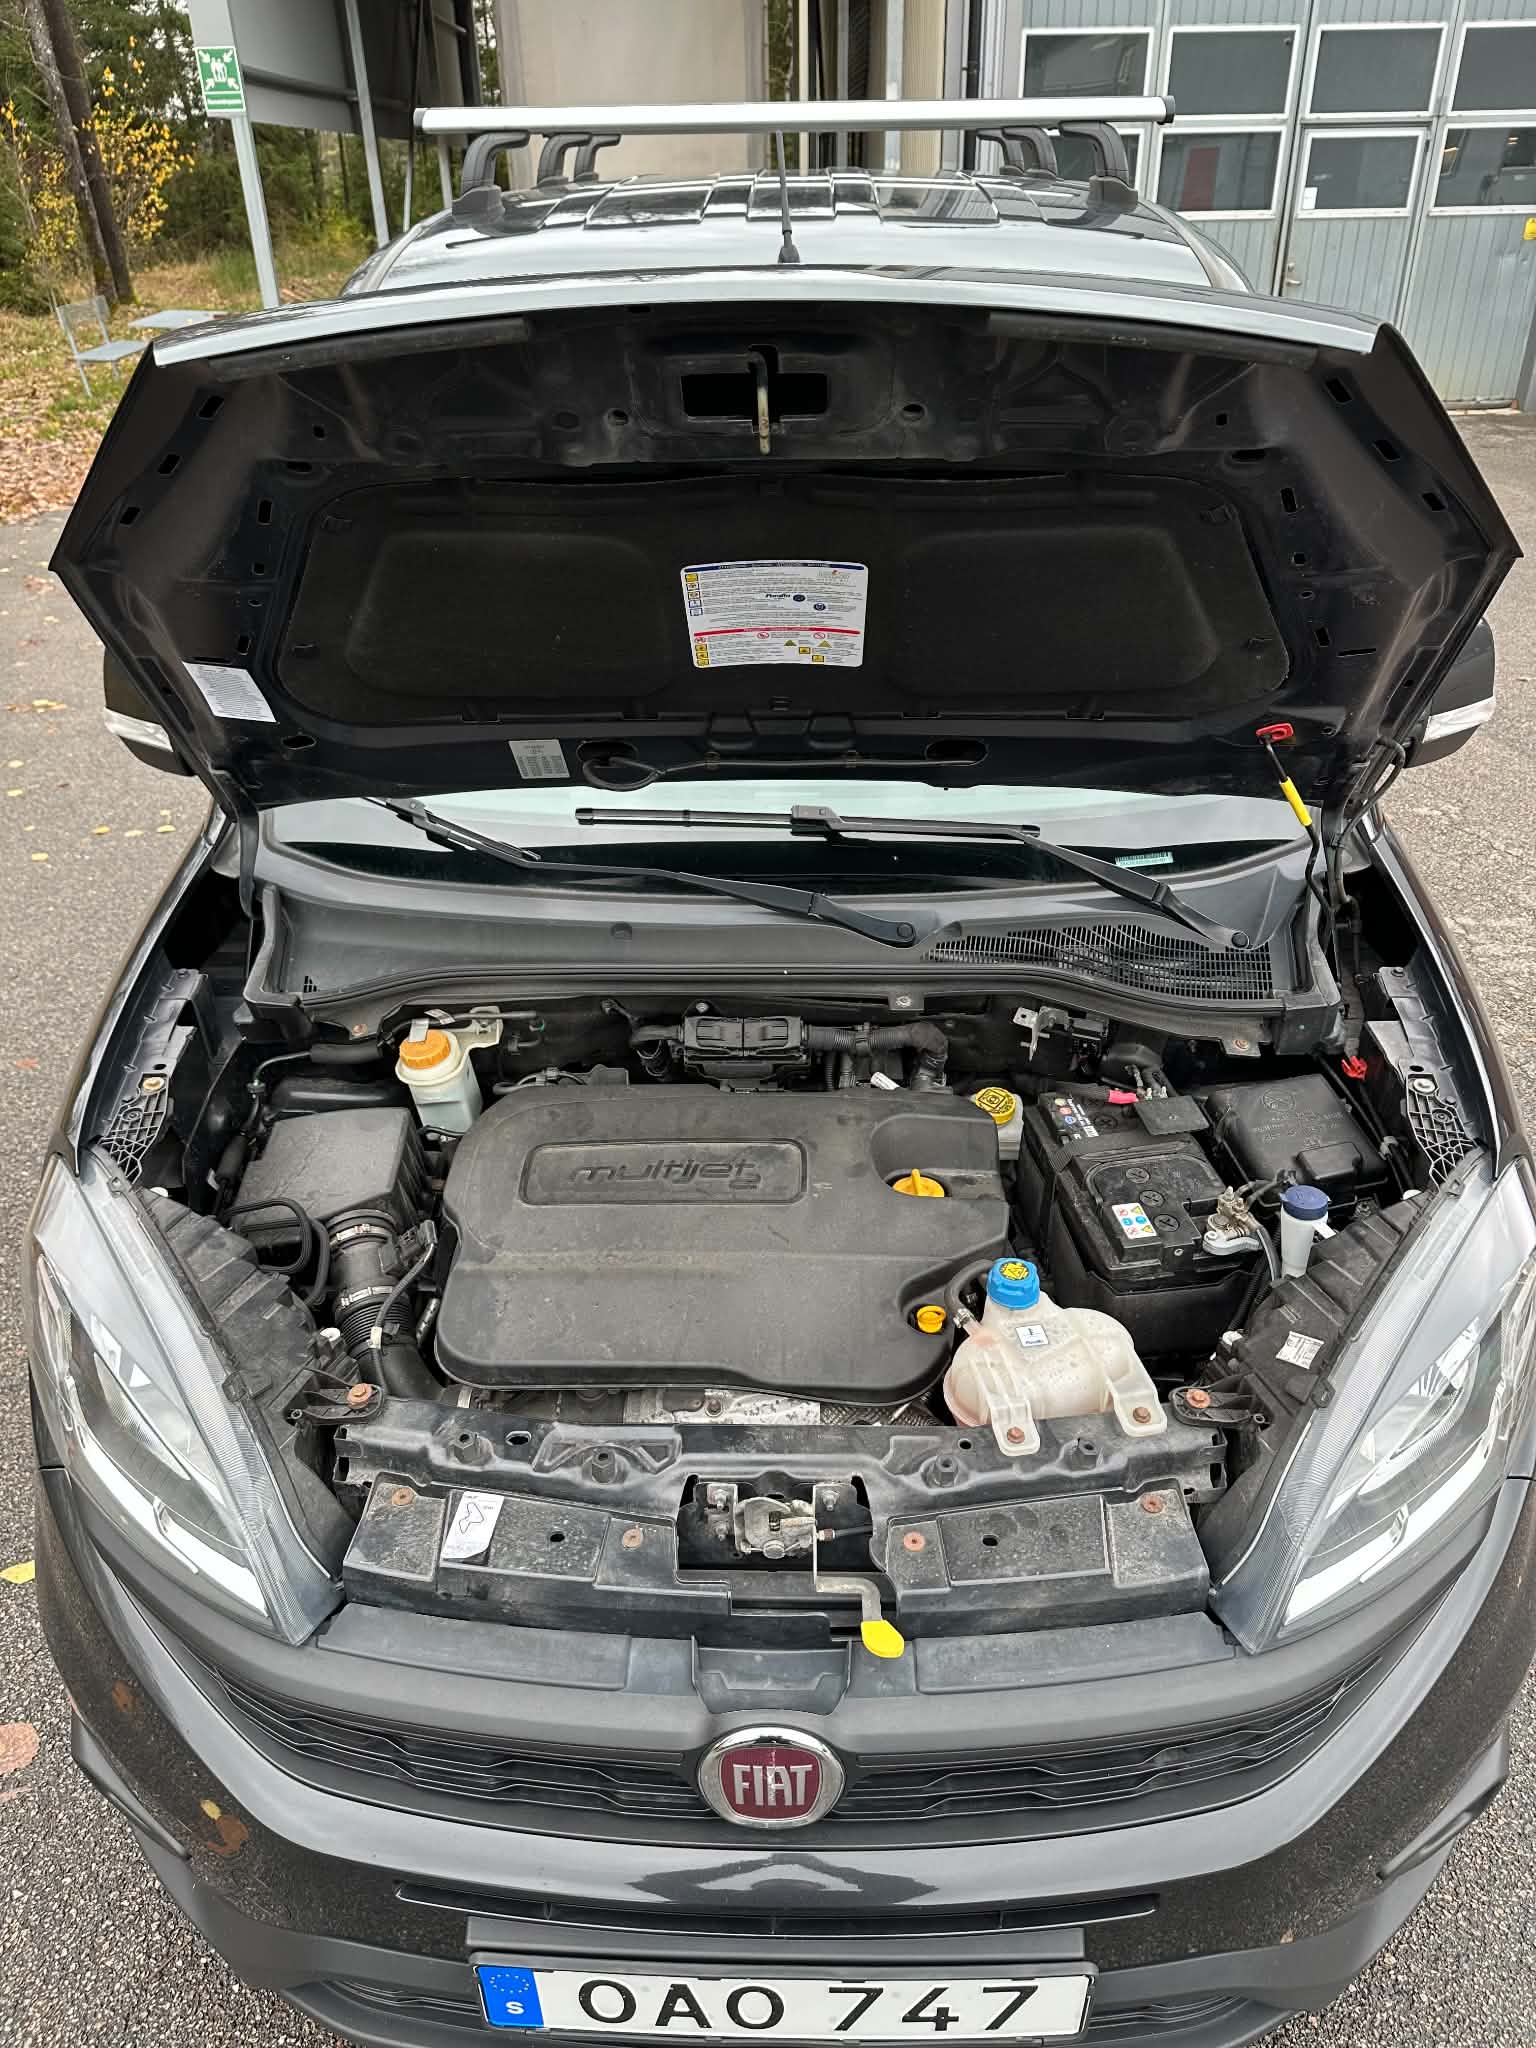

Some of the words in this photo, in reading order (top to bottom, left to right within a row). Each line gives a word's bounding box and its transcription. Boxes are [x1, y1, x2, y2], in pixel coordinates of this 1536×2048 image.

[733, 1764, 813, 1806] FIAT
[505, 2000, 525, 2015] S
[578, 1978, 786, 2030] OAO
[827, 1984, 1040, 2032] 747
